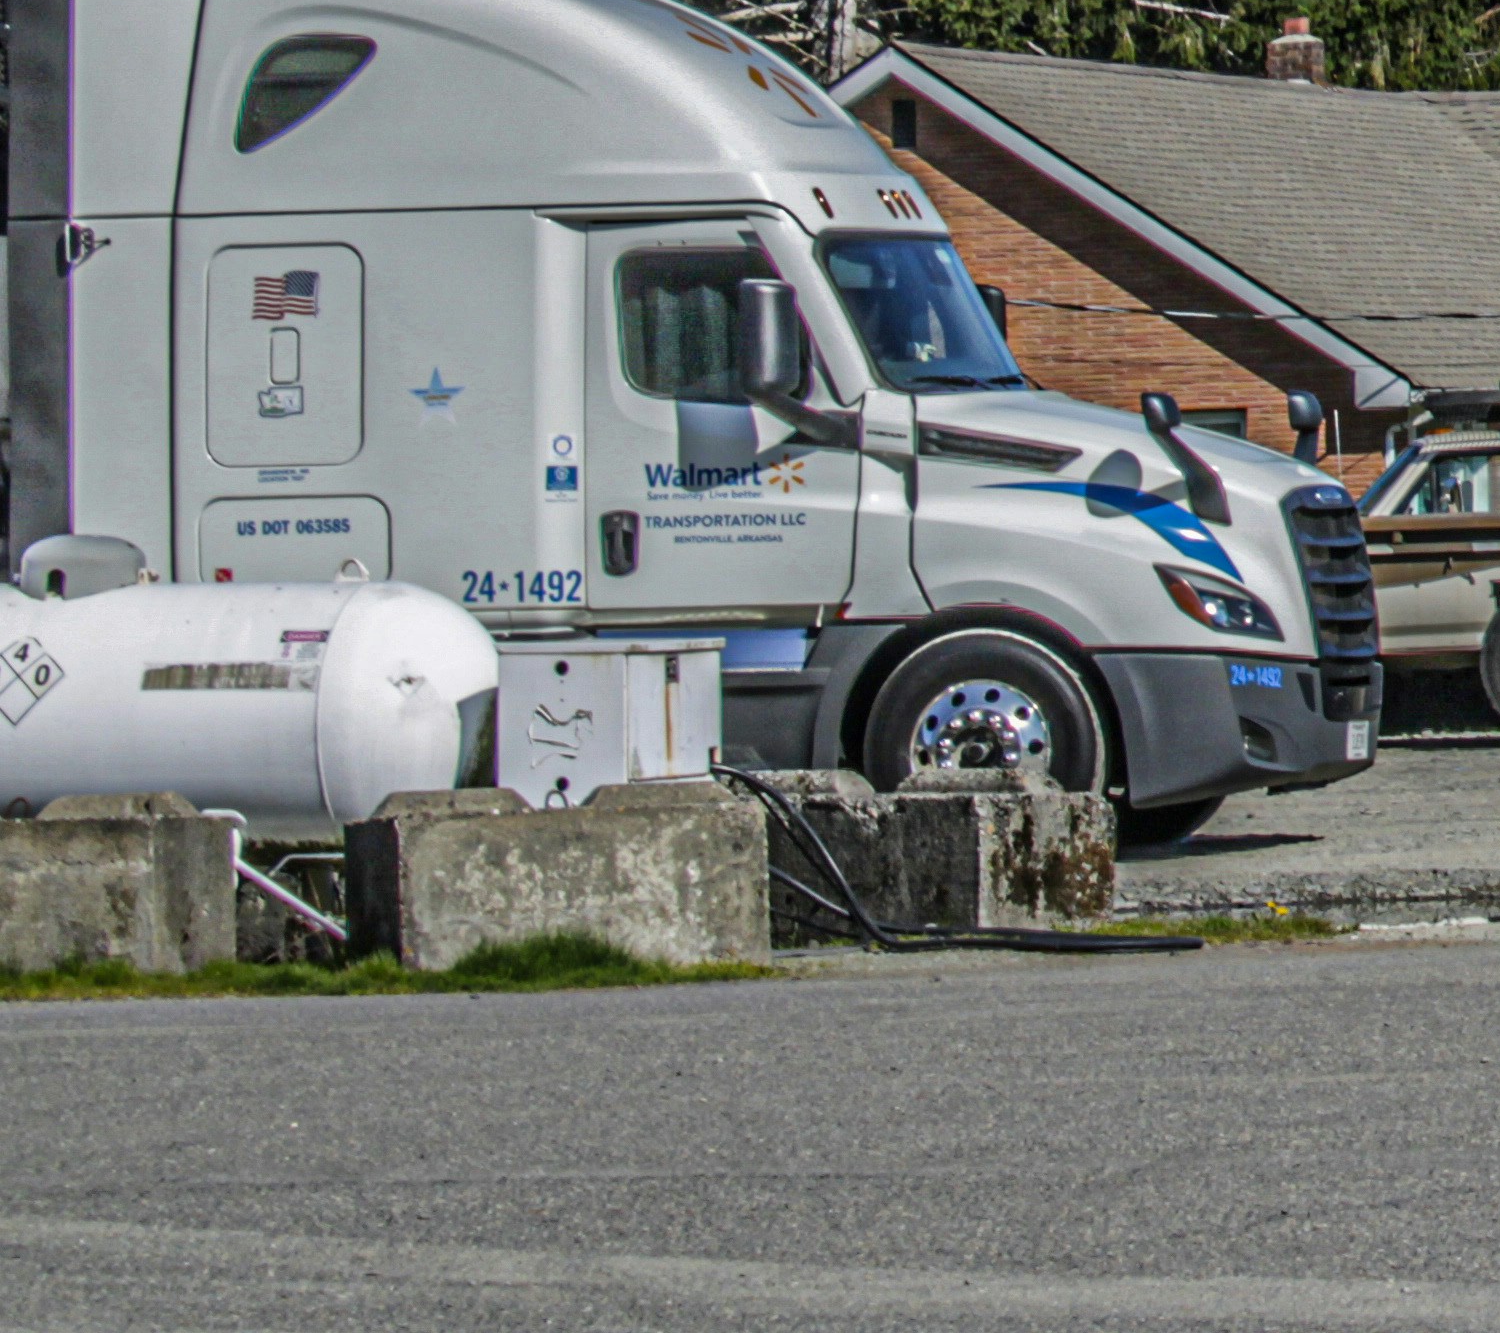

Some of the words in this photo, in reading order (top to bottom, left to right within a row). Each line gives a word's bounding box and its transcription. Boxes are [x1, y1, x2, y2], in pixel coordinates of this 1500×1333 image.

[645, 461, 762, 488] Walmart
[647, 490, 669, 501] Save
[672, 491, 704, 501] money.
[709, 489, 728, 500] Live
[731, 489, 764, 500] better.
[237, 520, 257, 536] US
[262, 519, 290, 535] DOT
[295, 517, 351, 534] 063585
[645, 513, 777, 529] TRANSPORTATION
[780, 512, 807, 527] LLC
[737, 534, 783, 543] ARKANSAS
[14, 643, 30, 662] 4
[34, 663, 51, 686] 0
